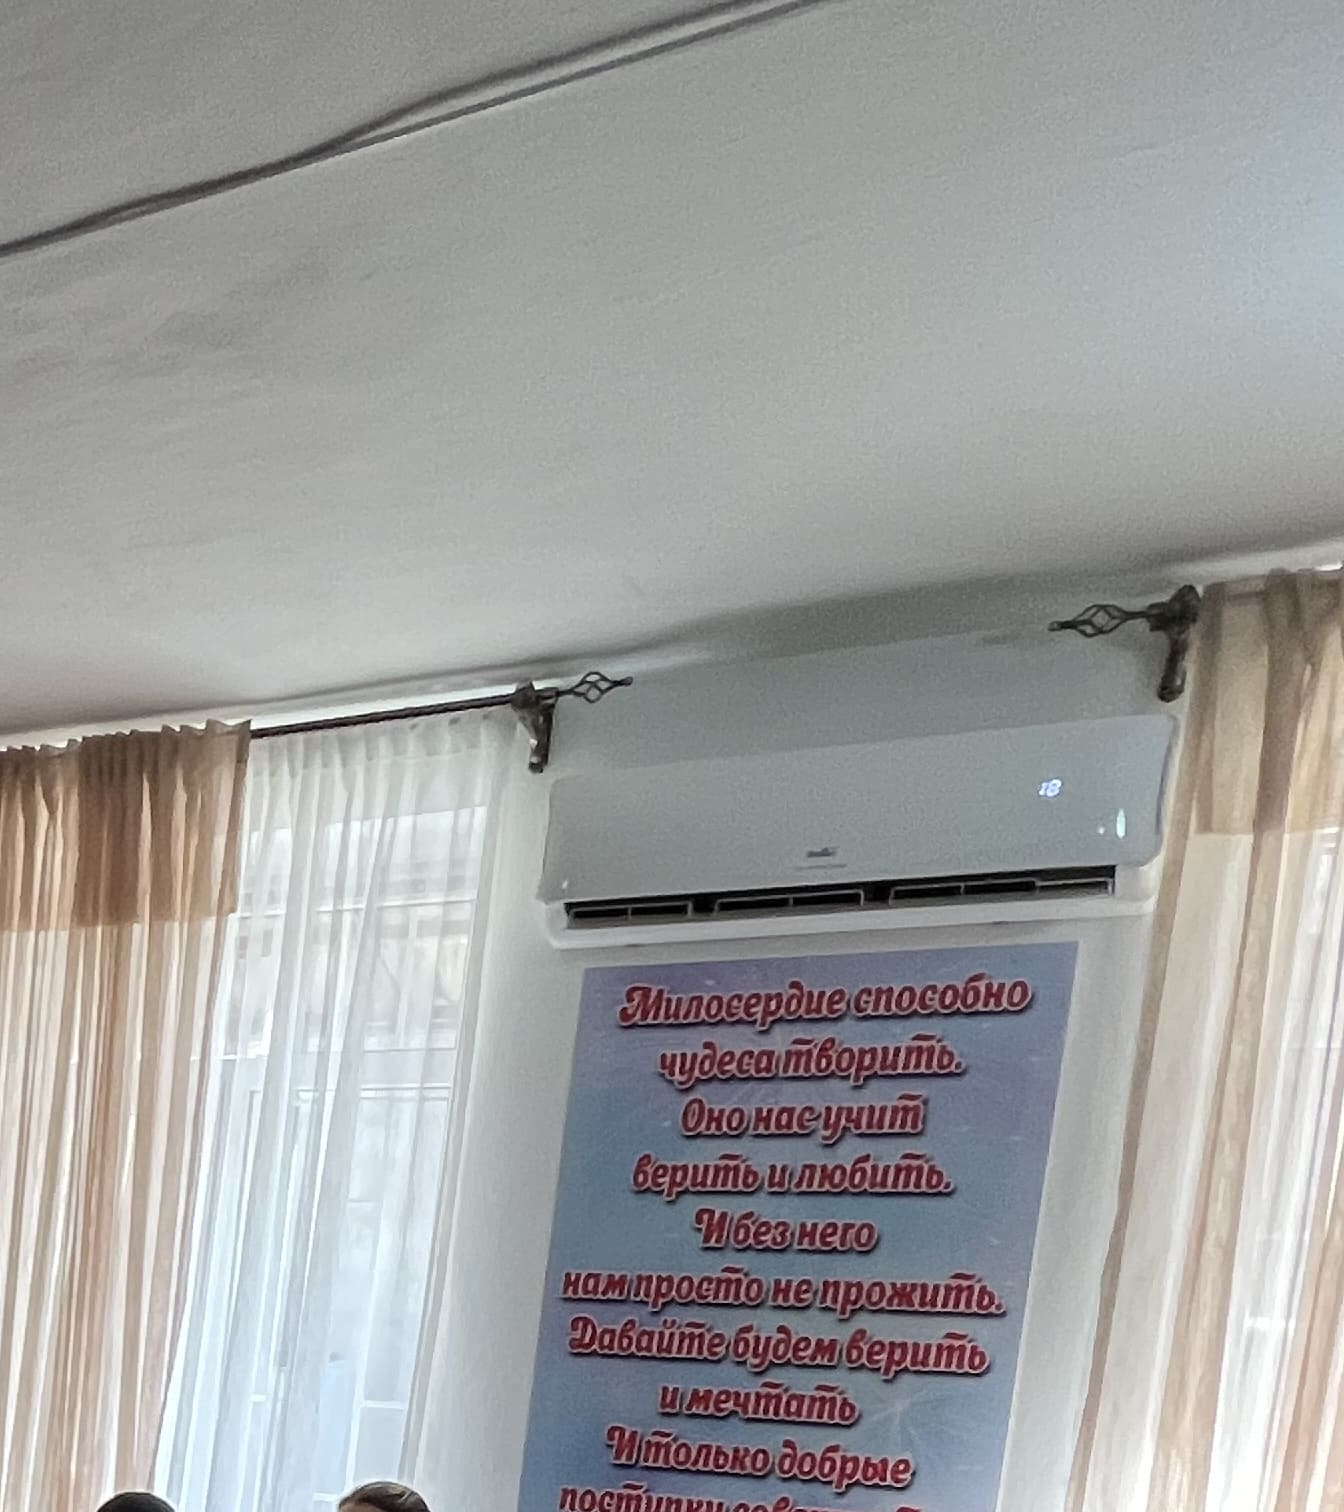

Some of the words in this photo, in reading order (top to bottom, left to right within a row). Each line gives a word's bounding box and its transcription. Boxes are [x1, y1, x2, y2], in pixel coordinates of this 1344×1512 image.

[619, 979, 848, 1033] Милосердие
[852, 972, 1033, 1018] способно
[659, 1042, 781, 1088] чудеса
[782, 1033, 967, 1086] творить.
[679, 1096, 747, 1136] Оно
[750, 1104, 819, 1136] нас
[820, 1093, 927, 1144] учит
[632, 1152, 761, 1202] верить
[766, 1163, 792, 1192] и
[792, 1152, 956, 1195] любить.
[694, 1206, 731, 1249] И
[731, 1210, 793, 1249] без
[796, 1220, 879, 1250] него
[562, 1268, 630, 1300] нам
[632, 1266, 767, 1312] просто
[771, 1275, 814, 1306] не
[819, 1272, 1007, 1321] прожить.
[568, 1314, 728, 1362] Давайте
[730, 1324, 840, 1373] будем
[844, 1328, 992, 1381] верить
[658, 1383, 681, 1415] и
[684, 1381, 860, 1426] мечтать
[604, 1424, 642, 1466] И
[642, 1428, 773, 1476] только
[776, 1438, 916, 1494] добрые
